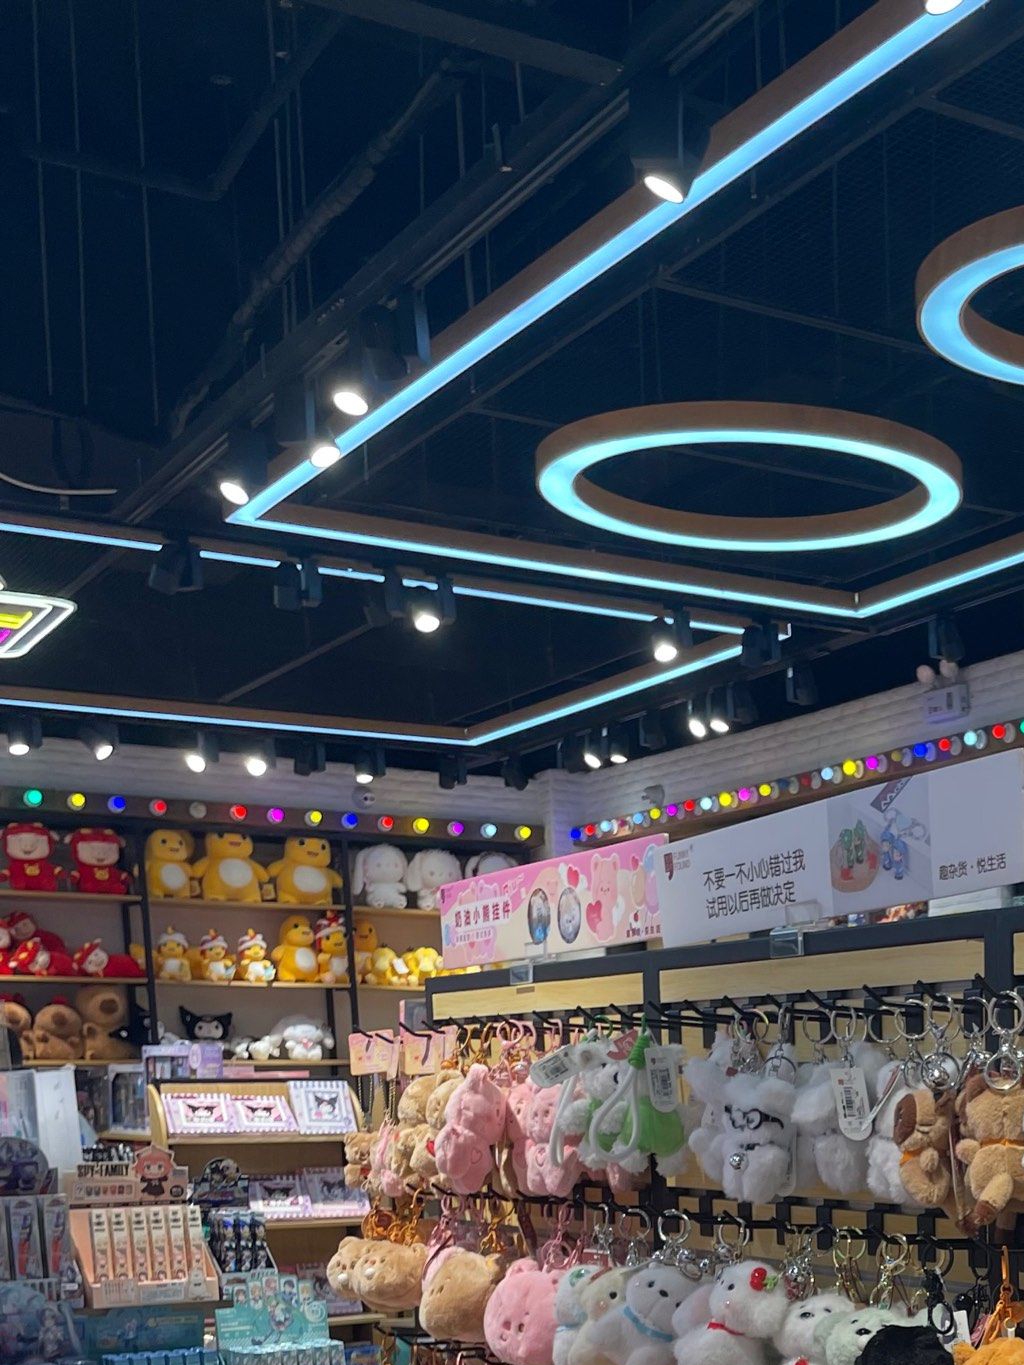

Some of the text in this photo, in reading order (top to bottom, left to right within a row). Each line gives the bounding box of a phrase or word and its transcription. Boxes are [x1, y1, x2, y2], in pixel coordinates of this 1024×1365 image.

[703, 848, 806, 892] 不要一不小心错过我
[706, 881, 797, 919] 试用以后再做决定
